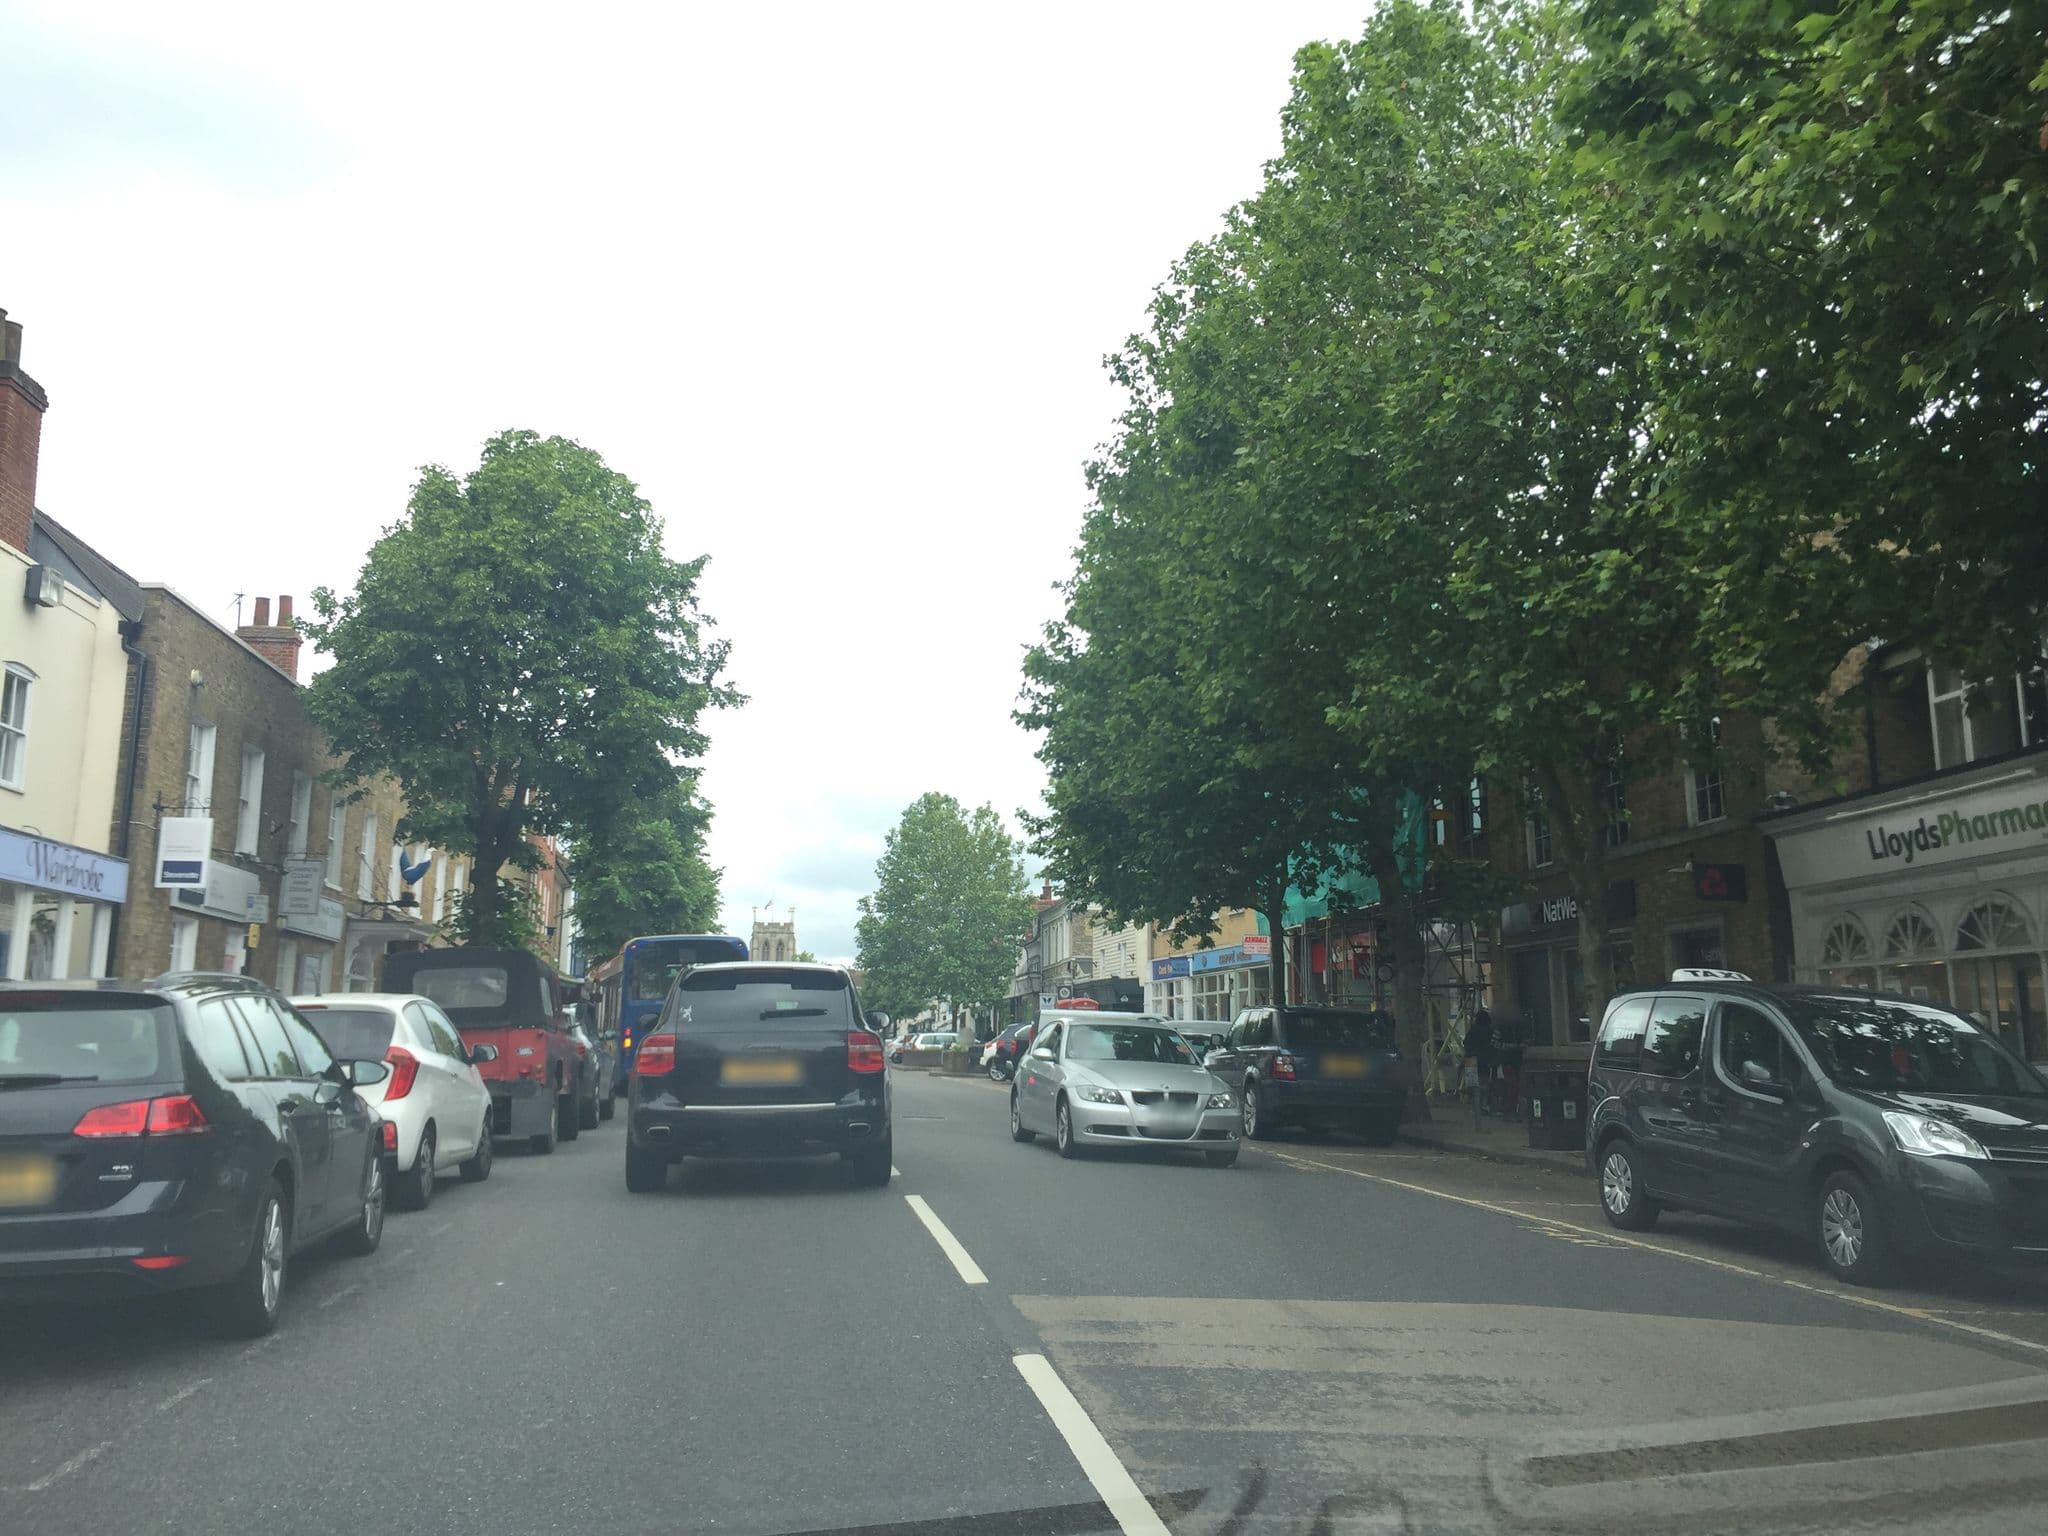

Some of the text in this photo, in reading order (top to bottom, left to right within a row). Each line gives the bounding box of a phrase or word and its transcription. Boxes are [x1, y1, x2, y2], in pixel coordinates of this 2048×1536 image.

[26, 841, 104, 893] Wardrobe
[1542, 896, 1577, 923] NatWe
[1683, 969, 1747, 981] TAXI
